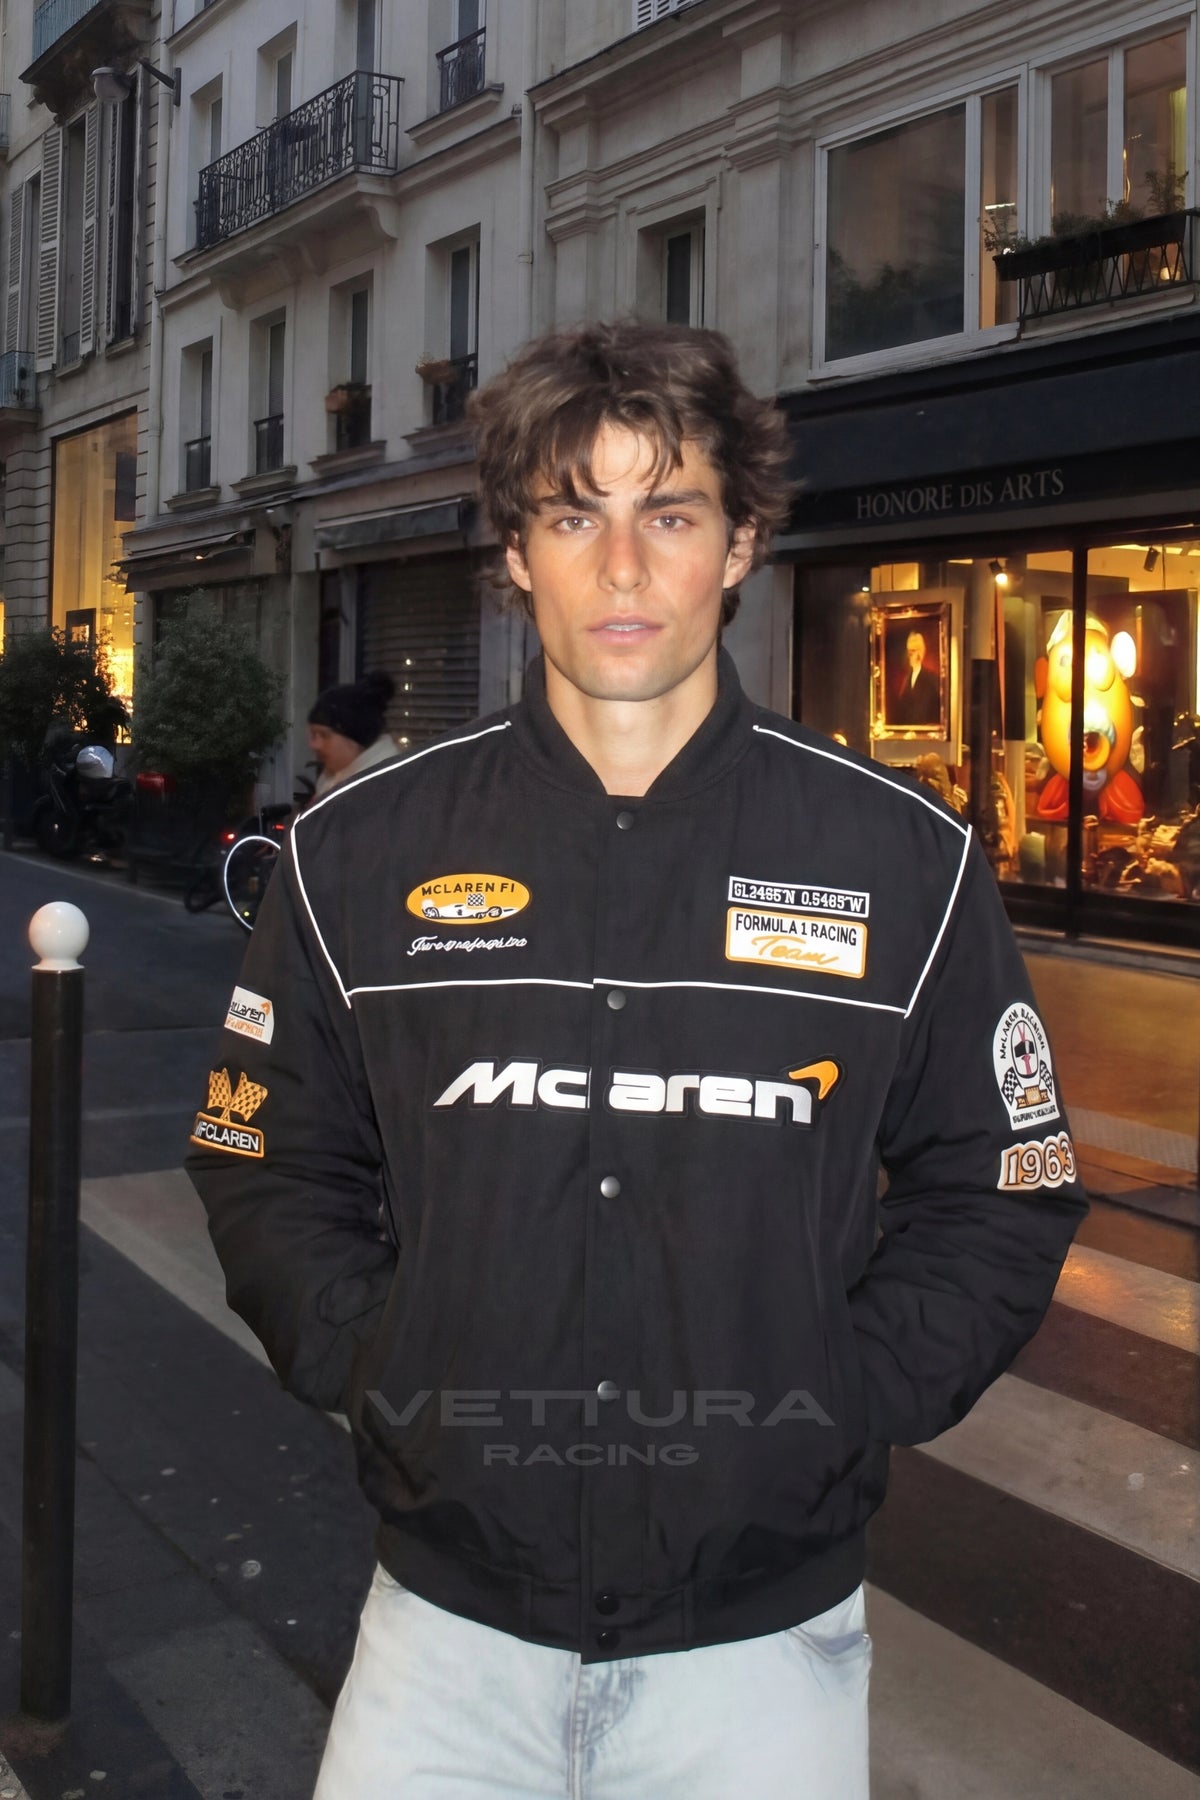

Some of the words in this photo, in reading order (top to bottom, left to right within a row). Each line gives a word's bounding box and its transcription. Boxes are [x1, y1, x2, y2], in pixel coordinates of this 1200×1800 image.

[856, 483, 953, 520] HONORE
[999, 468, 1066, 503] ARTS
[735, 913, 798, 935] FORMULA
[801, 922, 808, 936] 1
[810, 923, 858, 946] RACING
[751, 935, 840, 966] Team
[1005, 1138, 1076, 1187] 1963
